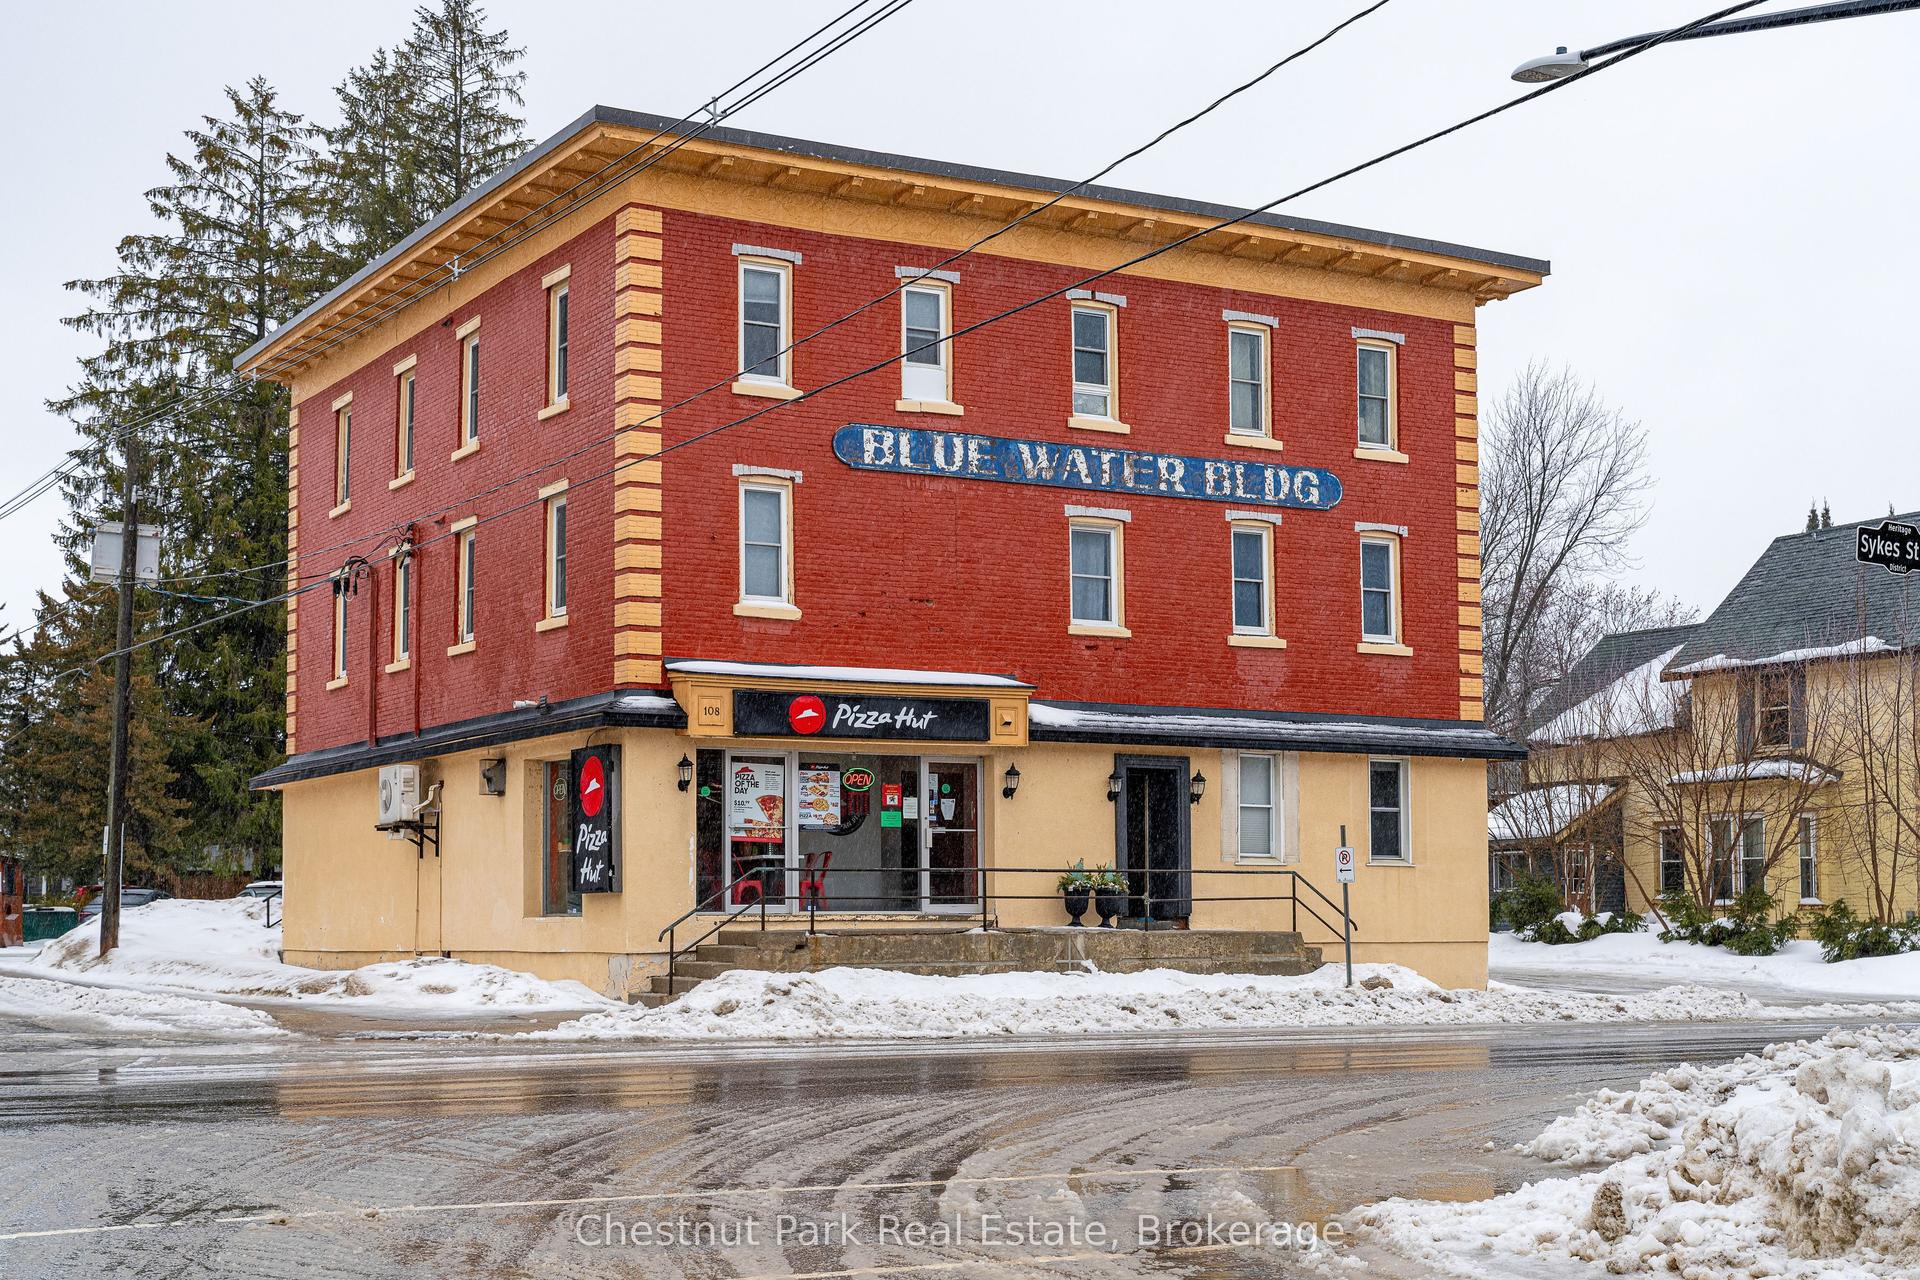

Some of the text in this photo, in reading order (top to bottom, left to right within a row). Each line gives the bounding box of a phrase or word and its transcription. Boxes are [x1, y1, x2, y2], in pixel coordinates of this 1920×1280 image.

[863, 429, 1320, 504] BLUE WATER BLDG
[1888, 524, 1911, 535] Heritage
[1861, 534, 1919, 560] Sykes St
[1889, 563, 1907, 572] District
[703, 706, 720, 716] 108
[832, 703, 938, 730] Pizza Hut
[734, 773, 755, 782] PIZZA
[844, 773, 872, 786] OPEN
[734, 780, 760, 789] OF THE
[734, 787, 748, 795] DAY
[576, 823, 608, 854] Pizza
[580, 856, 605, 884] Hut
